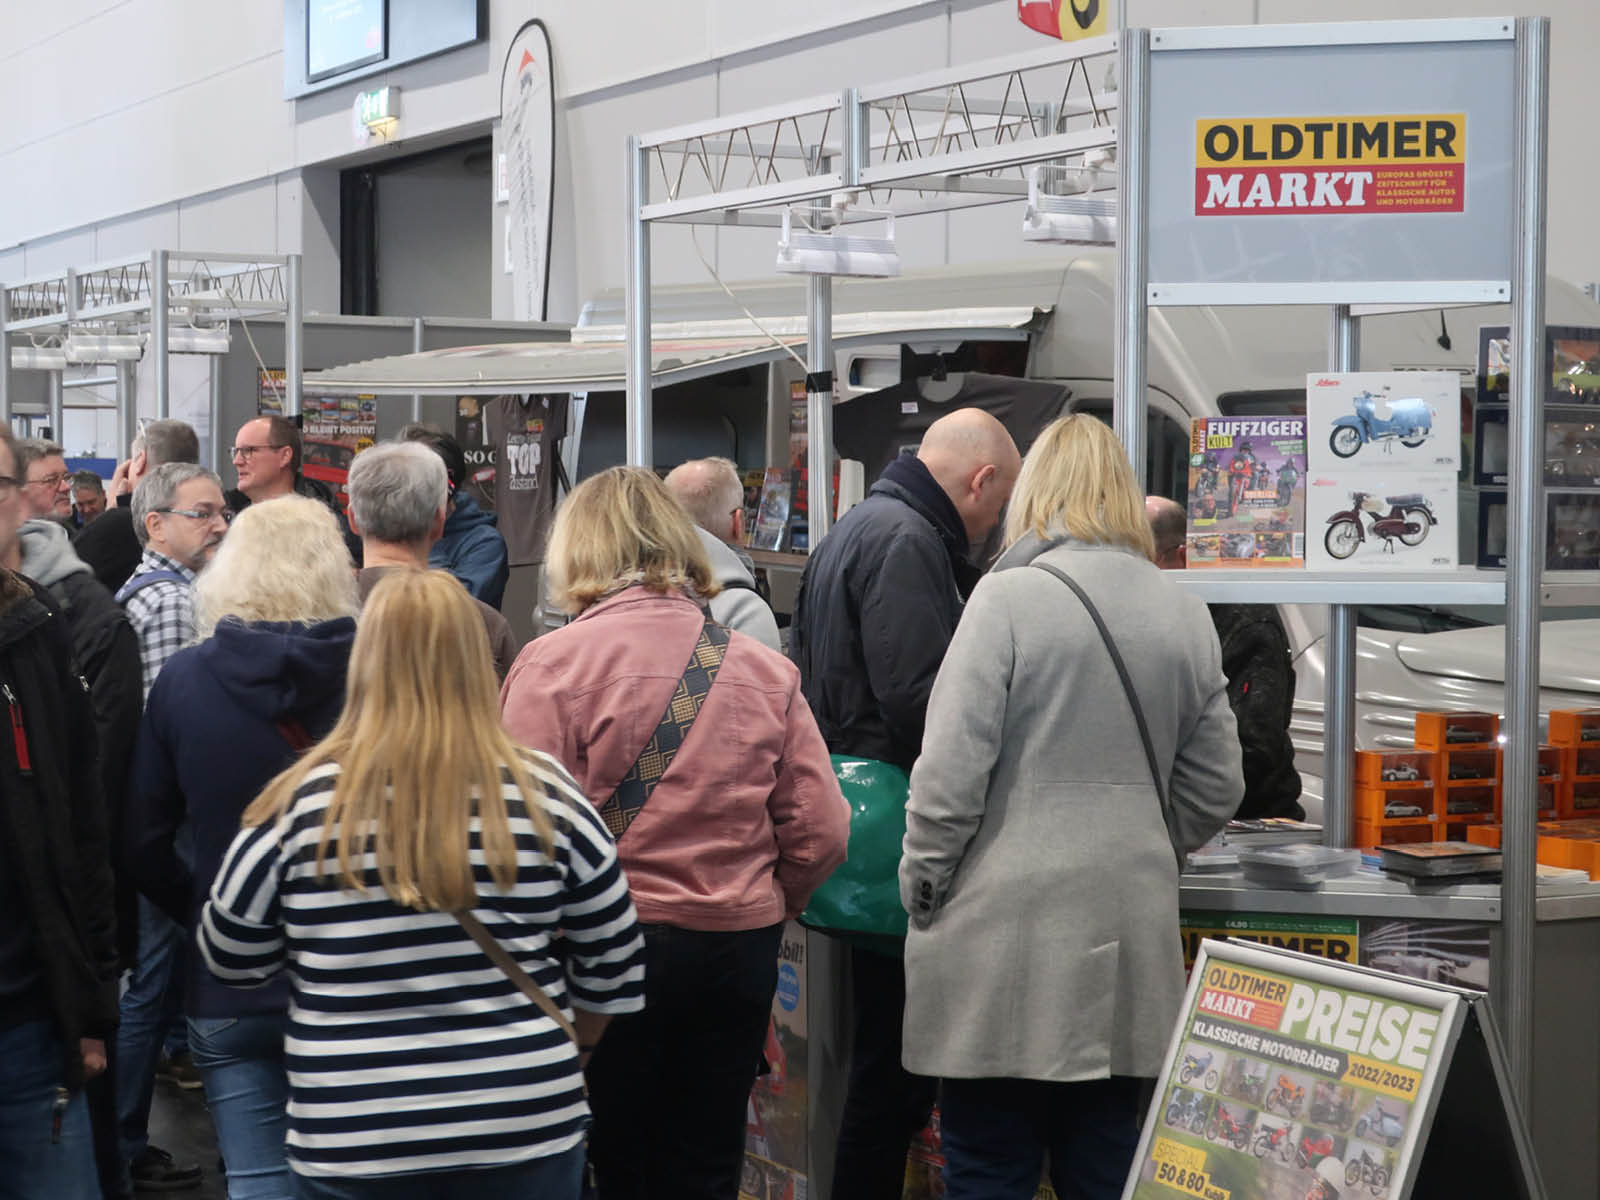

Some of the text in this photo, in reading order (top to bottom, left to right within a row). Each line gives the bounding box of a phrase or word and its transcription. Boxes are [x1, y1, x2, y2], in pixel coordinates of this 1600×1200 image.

[1203, 120, 1457, 162] OLDTIMER
[1202, 170, 1374, 209] MARKT
[1376, 171, 1415, 179] EUROPAS
[1376, 178, 1447, 188] ZEITSCHRIFT FÜR
[1376, 188, 1456, 197] KLASSISCHE AUTOS
[1376, 196, 1454, 206] UND MOTORRÄDER
[339, 425, 375, 435] POSITIV!
[1207, 421, 1305, 437] FUFFZIGER
[507, 442, 541, 475] TOP
[1209, 967, 1287, 1003] OLDTIMER
[1200, 991, 1256, 1020] MARKT
[1279, 983, 1441, 1070] PREISE
[1192, 1020, 1340, 1074] KLASSISCHE MOTORRÄDER
[1349, 1060, 1416, 1094] 2022/2023
[1158, 1162, 1177, 1182] 50
[1176, 1168, 1187, 1186] &
[1186, 1171, 1206, 1192] 80
